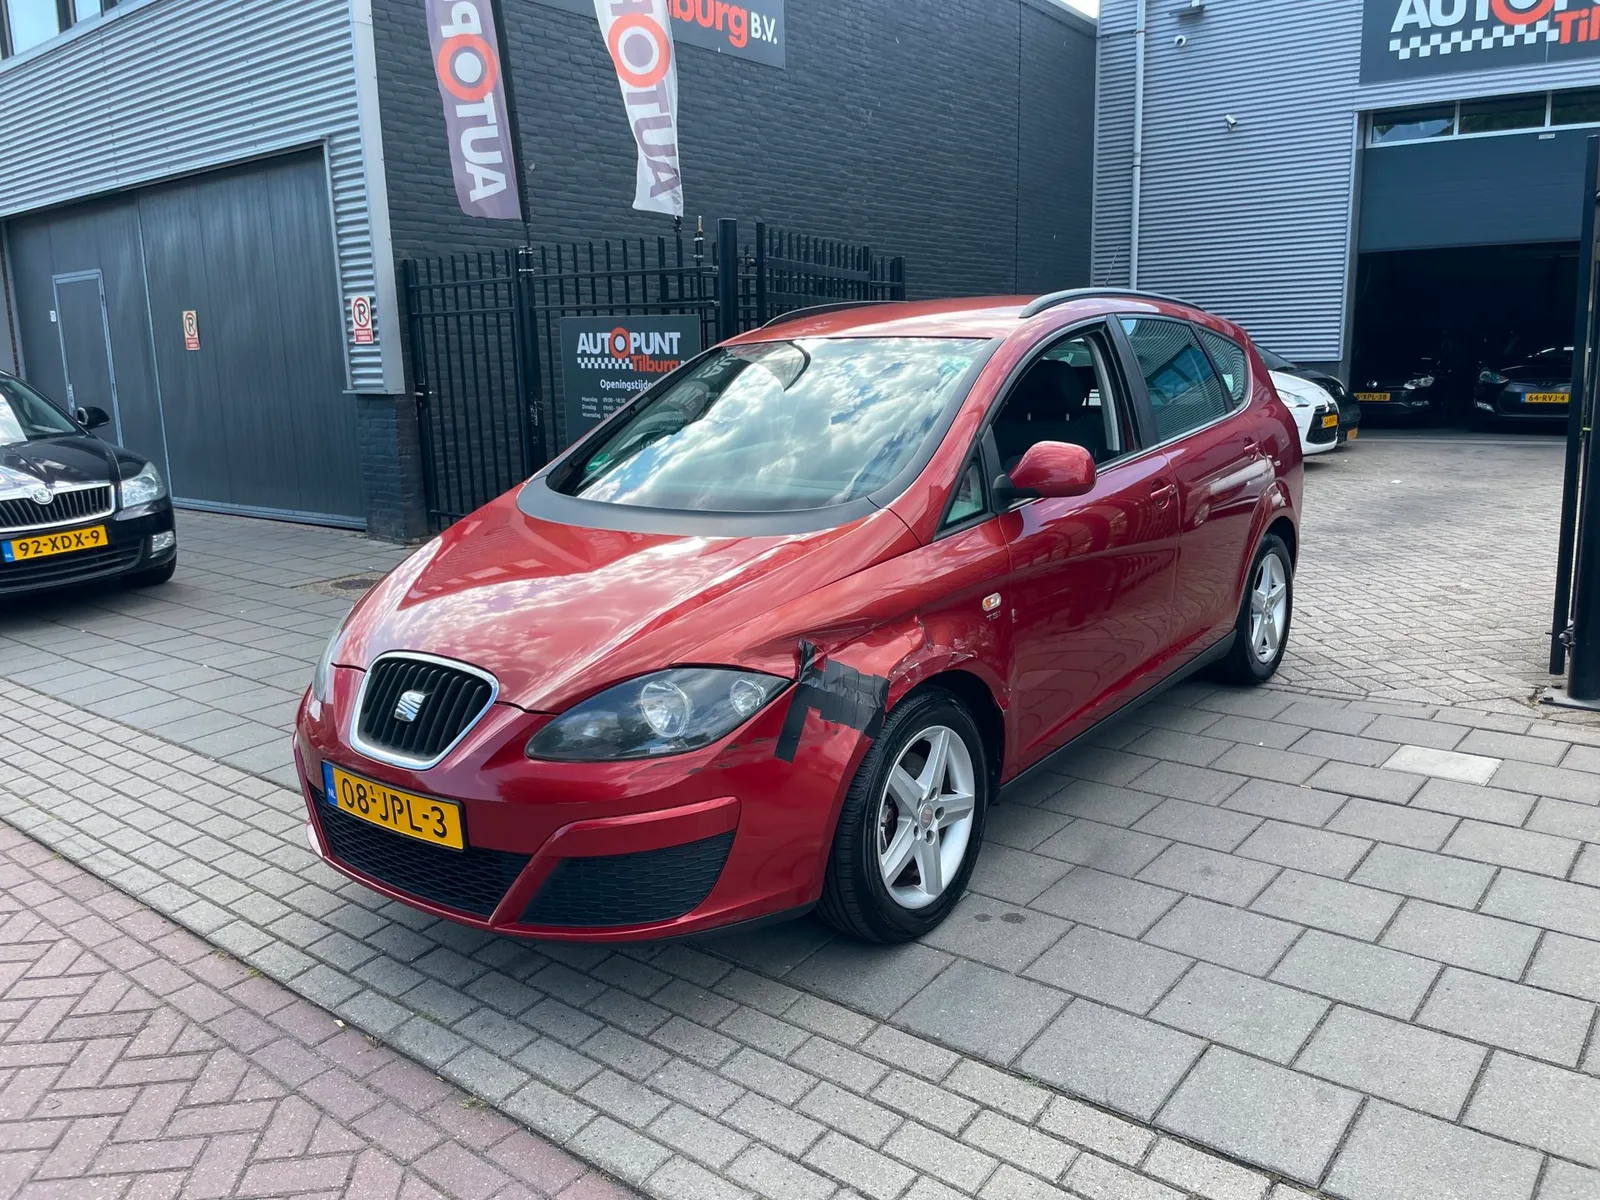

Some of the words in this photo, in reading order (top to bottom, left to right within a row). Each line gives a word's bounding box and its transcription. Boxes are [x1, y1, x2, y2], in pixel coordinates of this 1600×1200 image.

[668, 0, 748, 48] burg
[751, 11, 778, 45] B.V.
[577, 327, 681, 358] AUTOPUNT
[1528, 394, 1566, 402] 64-RVJ-4
[18, 530, 101, 556] 92-XDX-9
[327, 787, 337, 799] NL
[341, 777, 448, 839] 08-JPL-3
